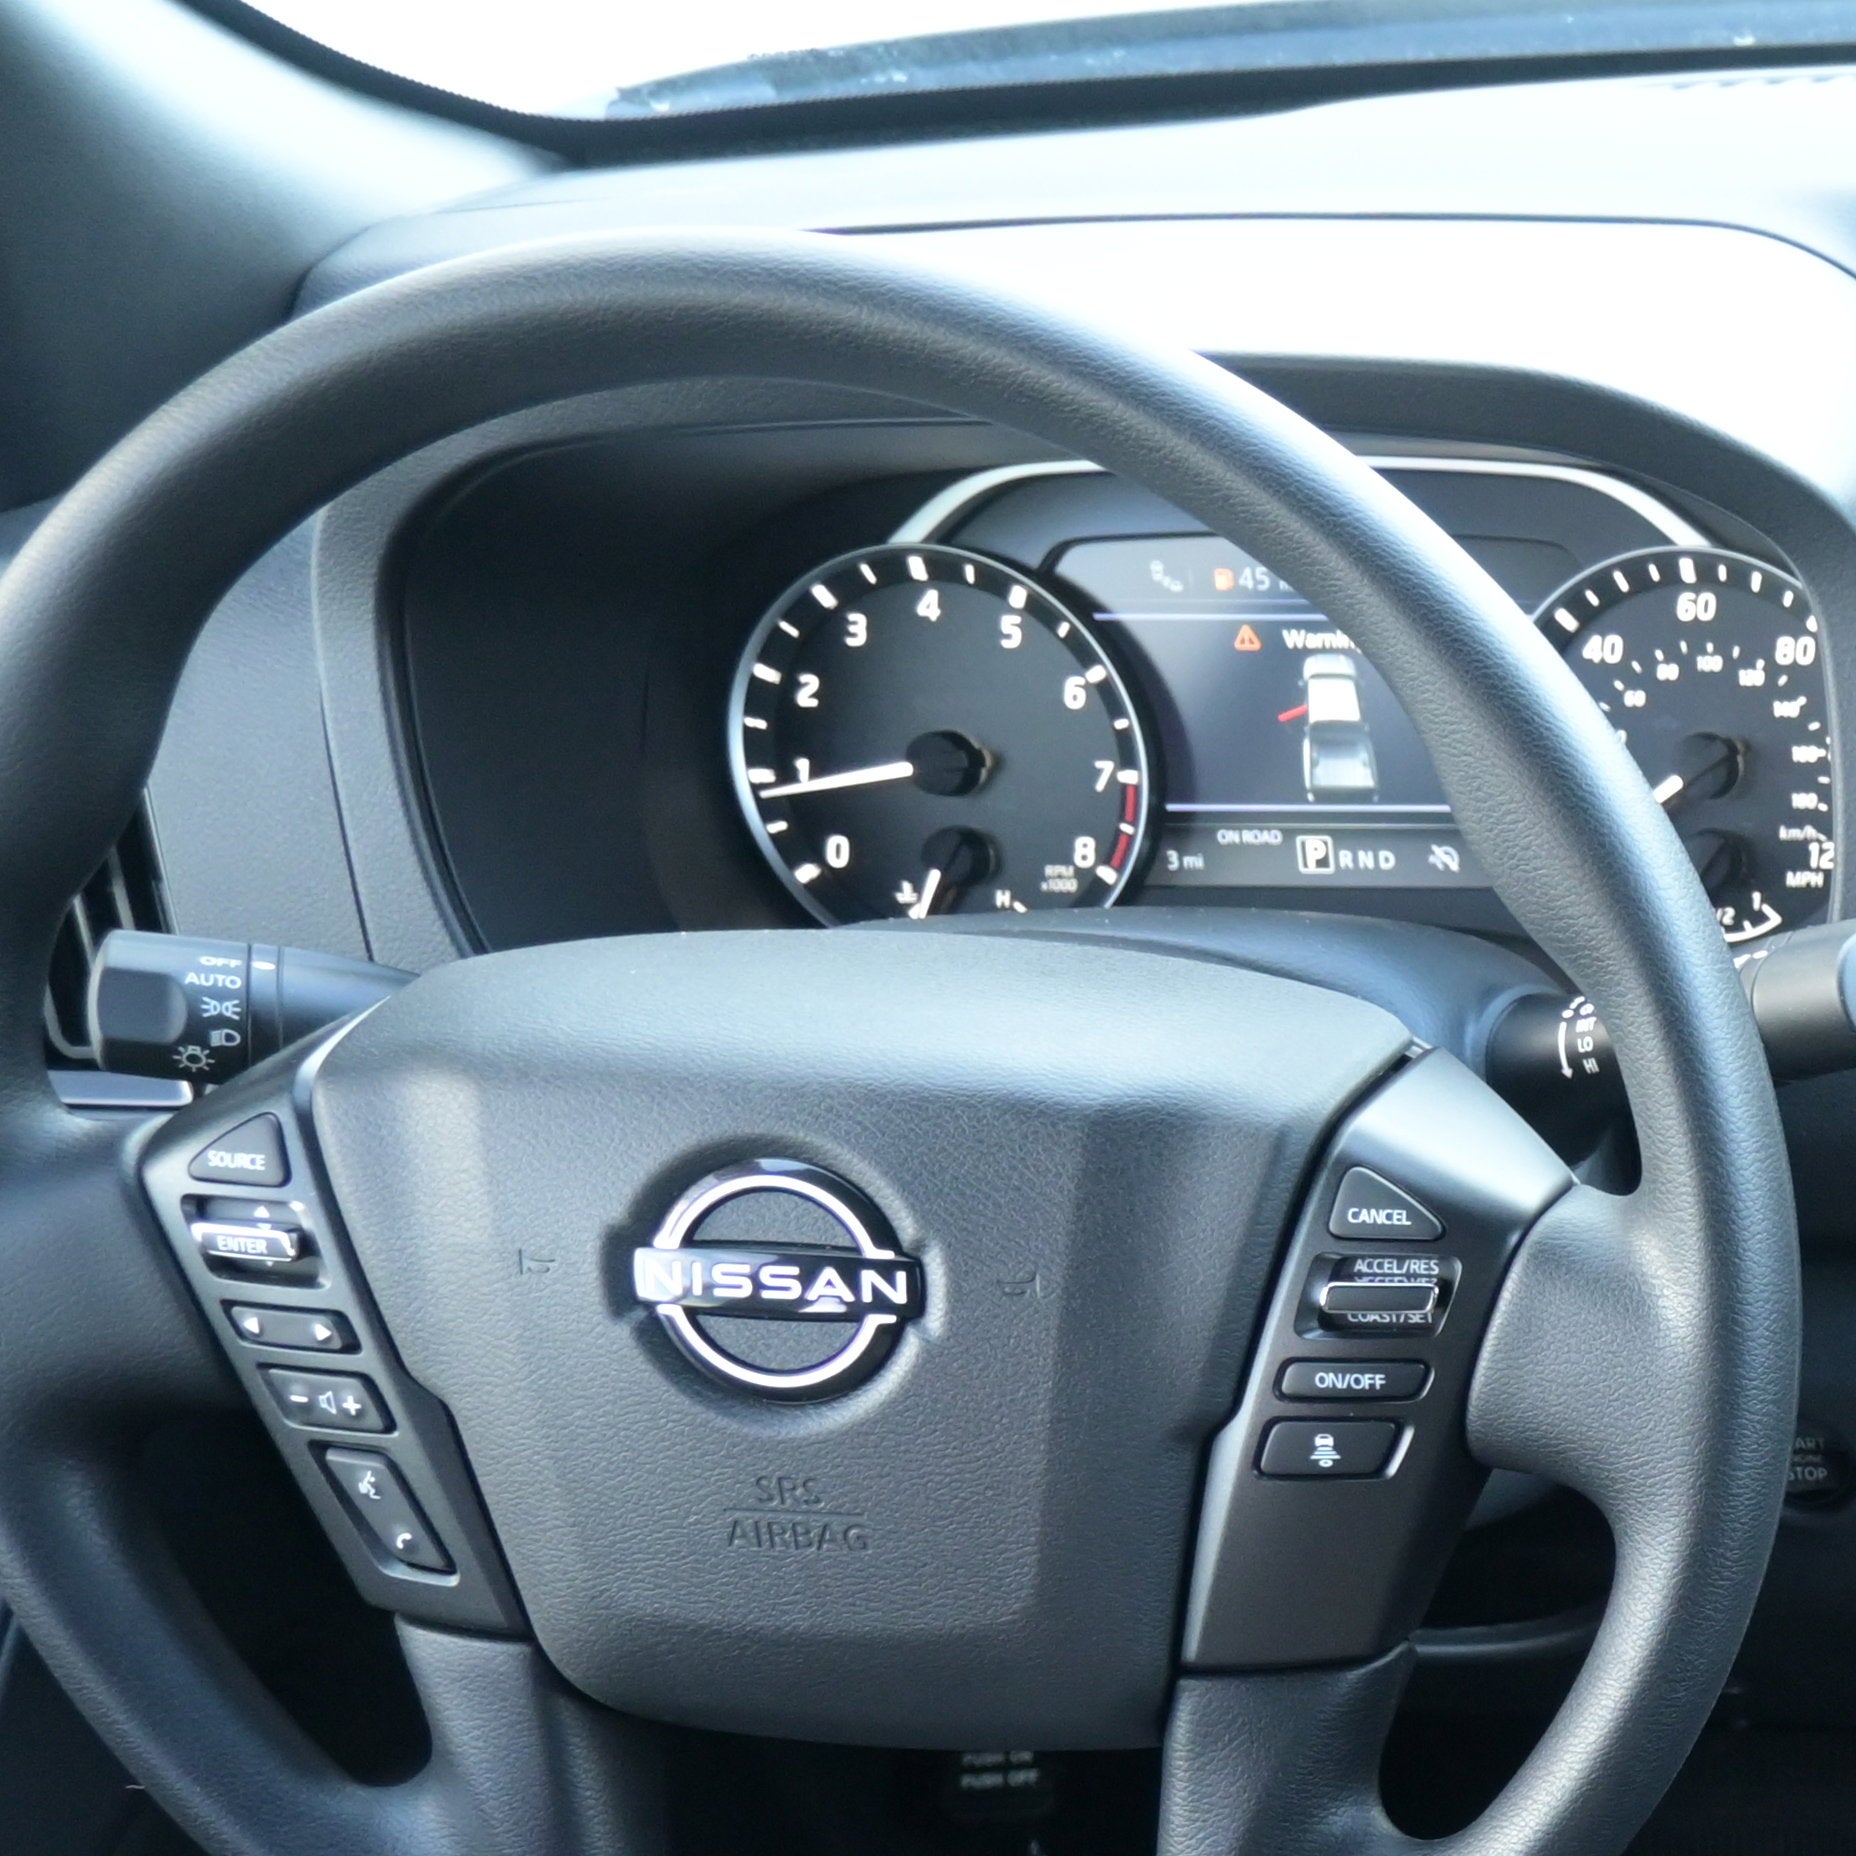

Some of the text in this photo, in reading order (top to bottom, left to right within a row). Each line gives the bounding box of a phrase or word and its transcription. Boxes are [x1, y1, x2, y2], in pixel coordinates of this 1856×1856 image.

[1239, 567, 1271, 591] 45
[917, 589, 942, 622] 4
[1676, 592, 1717, 622] 60
[845, 613, 868, 647] 3
[1000, 615, 1023, 649] 5
[1582, 634, 1623, 664] 40
[1775, 636, 1816, 666] 80
[796, 674, 820, 708] 2
[1063, 677, 1087, 710] 6
[1094, 761, 1114, 792] 7
[825, 835, 850, 868] 0
[1073, 836, 1097, 868] 8
[1217, 829, 1283, 846] ON ROAD
[1166, 850, 1204, 871] 3 mi
[1305, 838, 1396, 870] P R N D
[1786, 871, 1824, 888] MPH
[995, 889, 1011, 908] H
[199, 956, 242, 968] OFF
[185, 972, 242, 989] AUTO
[1577, 1036, 1594, 1053] LO
[1583, 1057, 1600, 1075] HI
[207, 1150, 265, 1171] SOURCE
[1348, 1207, 1412, 1225] CANCEL
[217, 1237, 267, 1255] ENTER
[1353, 1259, 1440, 1274] ACCEL/RES
[643, 1260, 907, 1304] NISSAN
[1315, 1373, 1386, 1390] ON/OFF
[754, 1478, 824, 1507] SRS
[726, 1520, 868, 1553] AIRBAG
